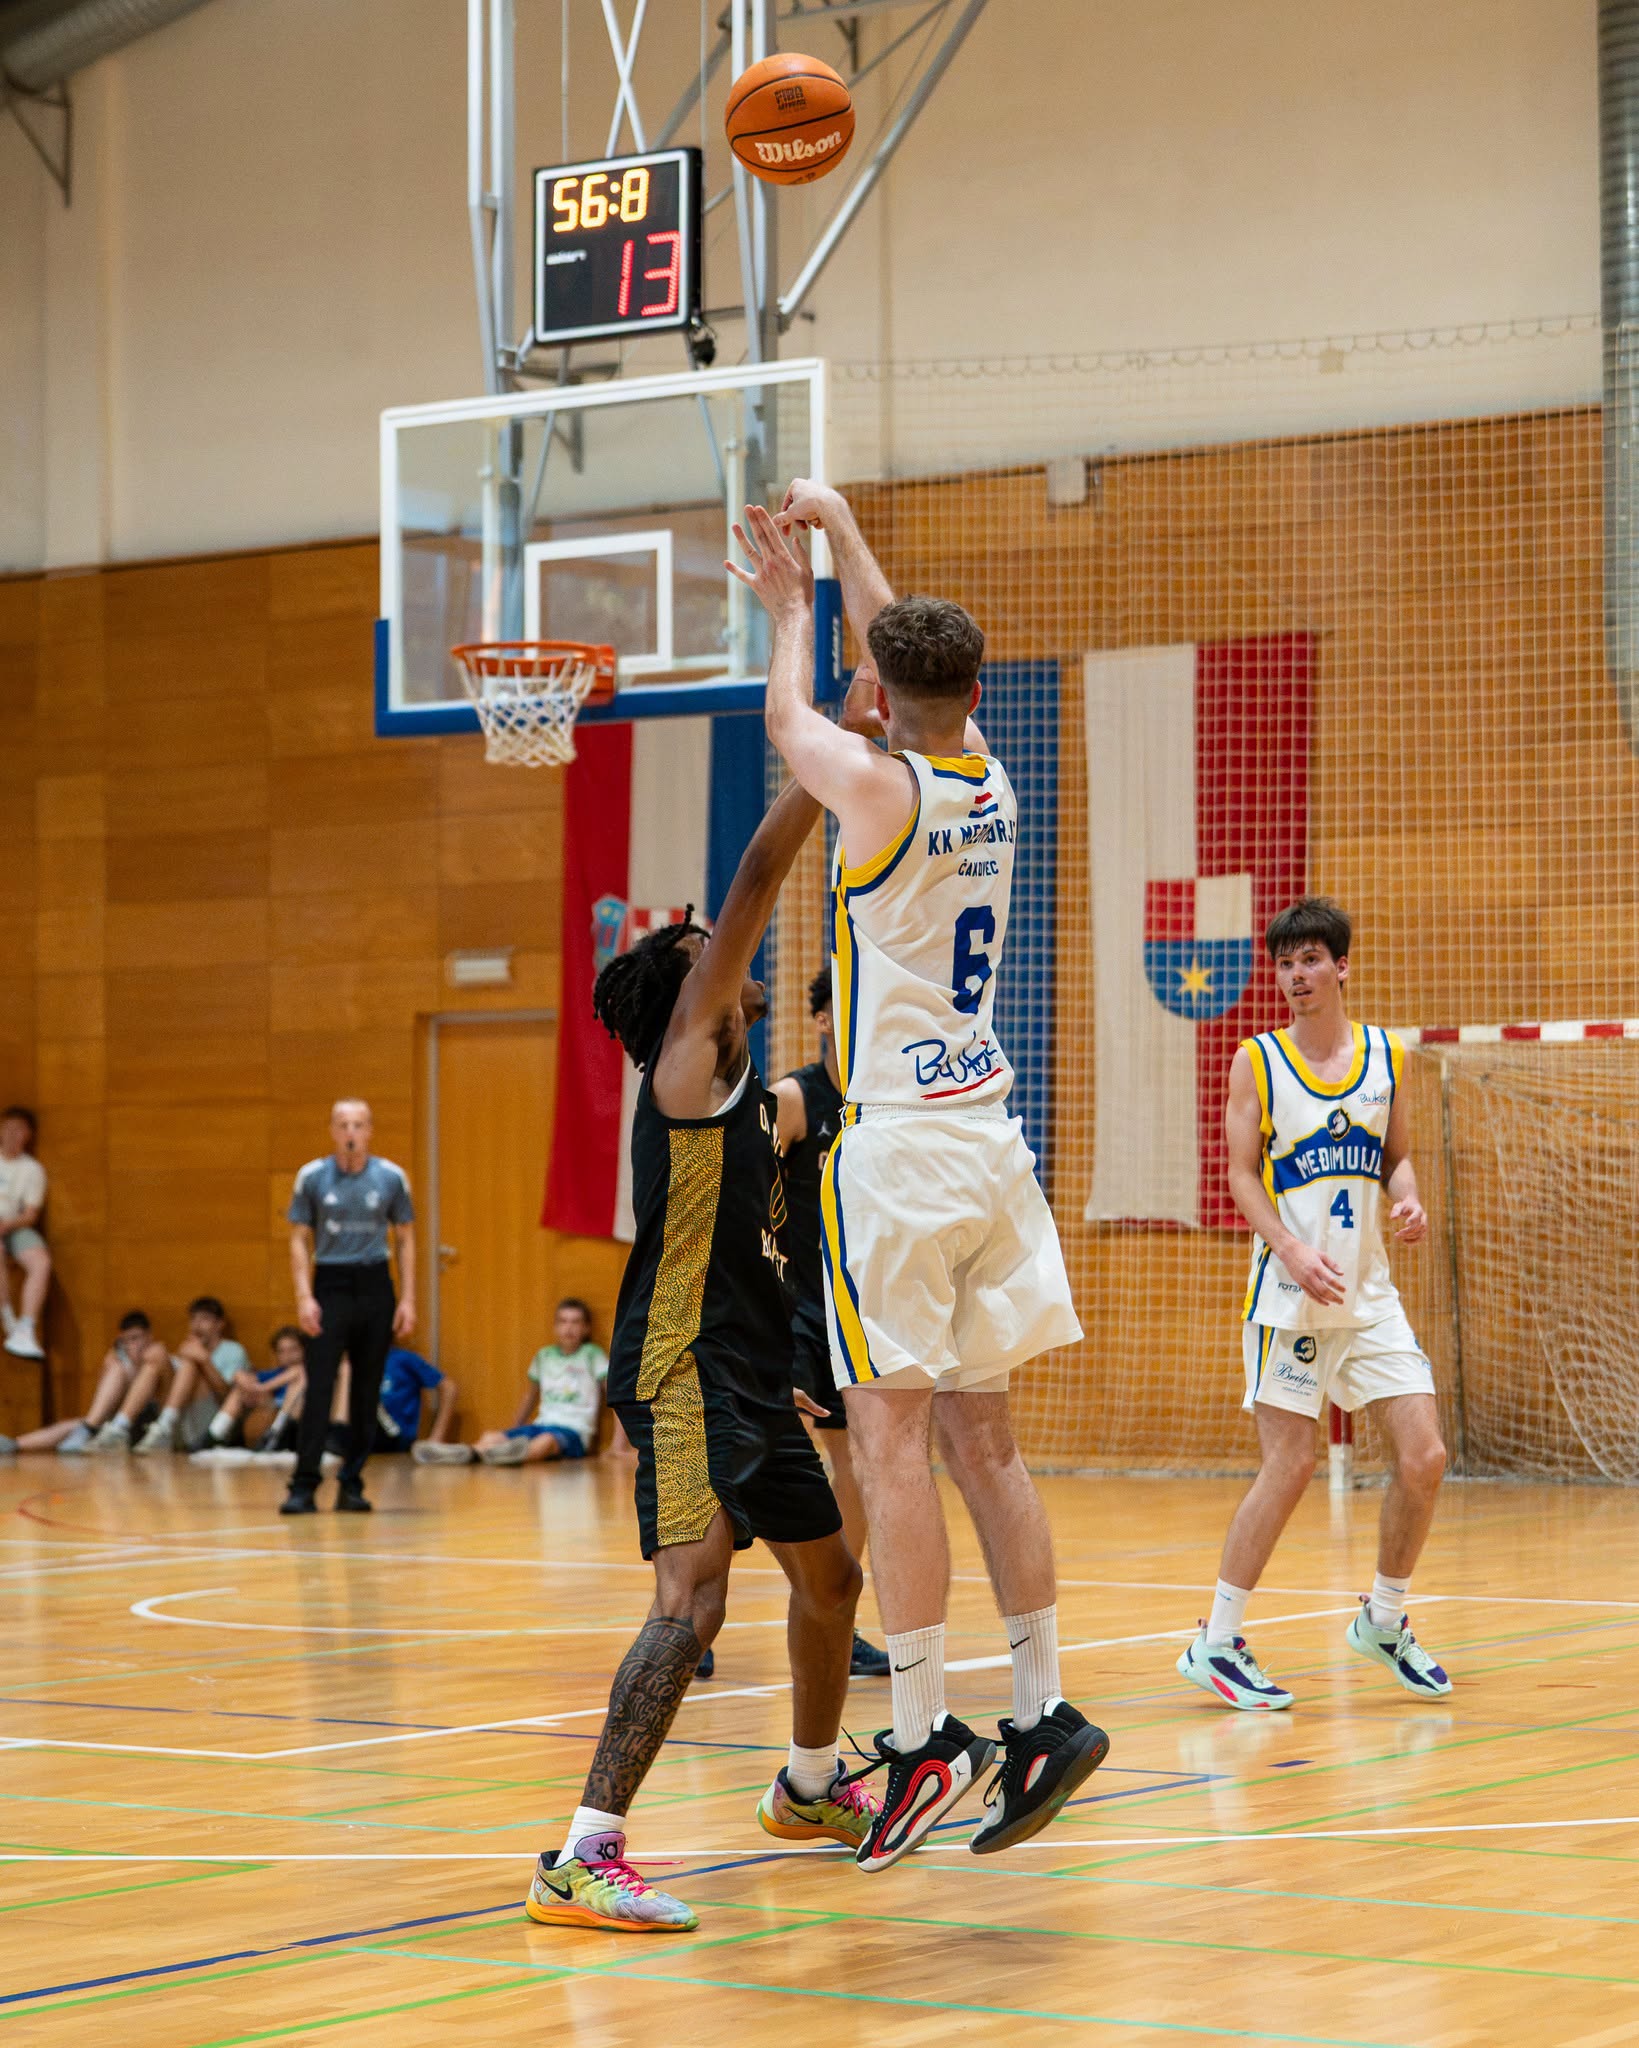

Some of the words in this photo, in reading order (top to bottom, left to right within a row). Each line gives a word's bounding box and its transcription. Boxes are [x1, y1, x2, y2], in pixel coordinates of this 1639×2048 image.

[754, 131, 842, 163] Wilson
[553, 168, 649, 233] 56:8
[618, 230, 680, 316] 13
[928, 829, 953, 856] KK
[952, 905, 995, 1015] 6
[1330, 1189, 1354, 1228] 4
